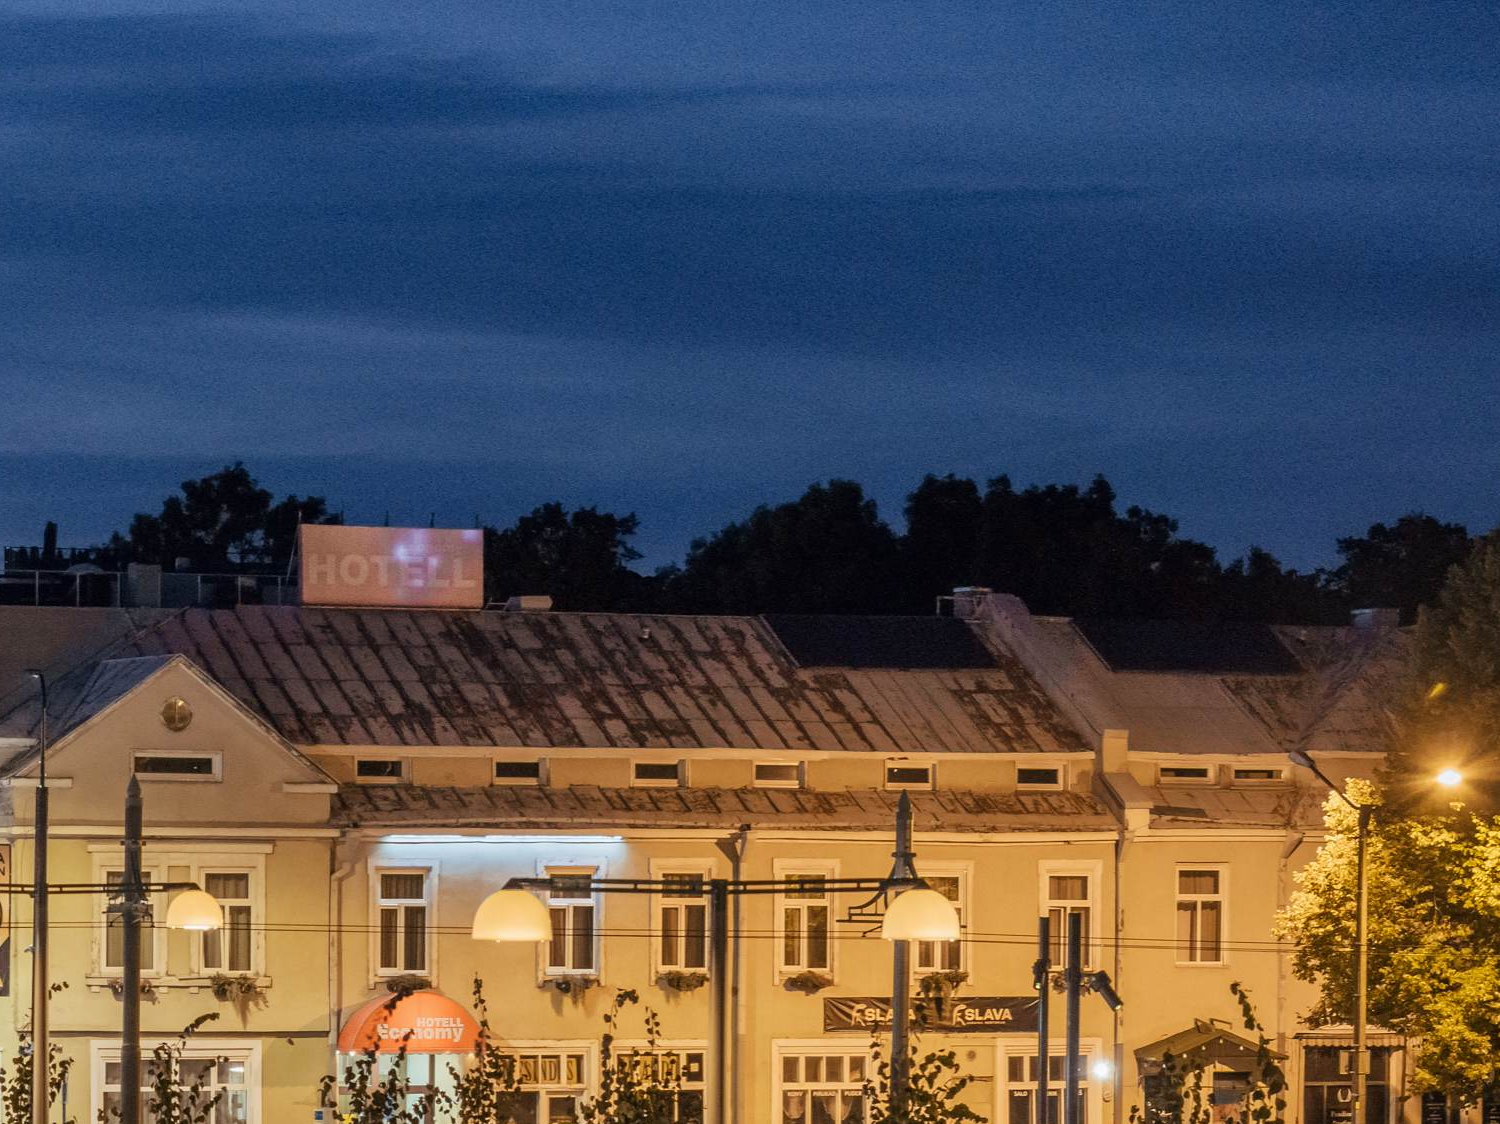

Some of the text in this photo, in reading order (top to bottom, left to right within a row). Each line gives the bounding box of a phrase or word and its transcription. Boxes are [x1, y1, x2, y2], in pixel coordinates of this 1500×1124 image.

[308, 553, 477, 588] HOTELL
[864, 1008, 916, 1021] SLAA
[964, 1008, 1013, 1021] SLAVA
[417, 1017, 464, 1028] HOTELL
